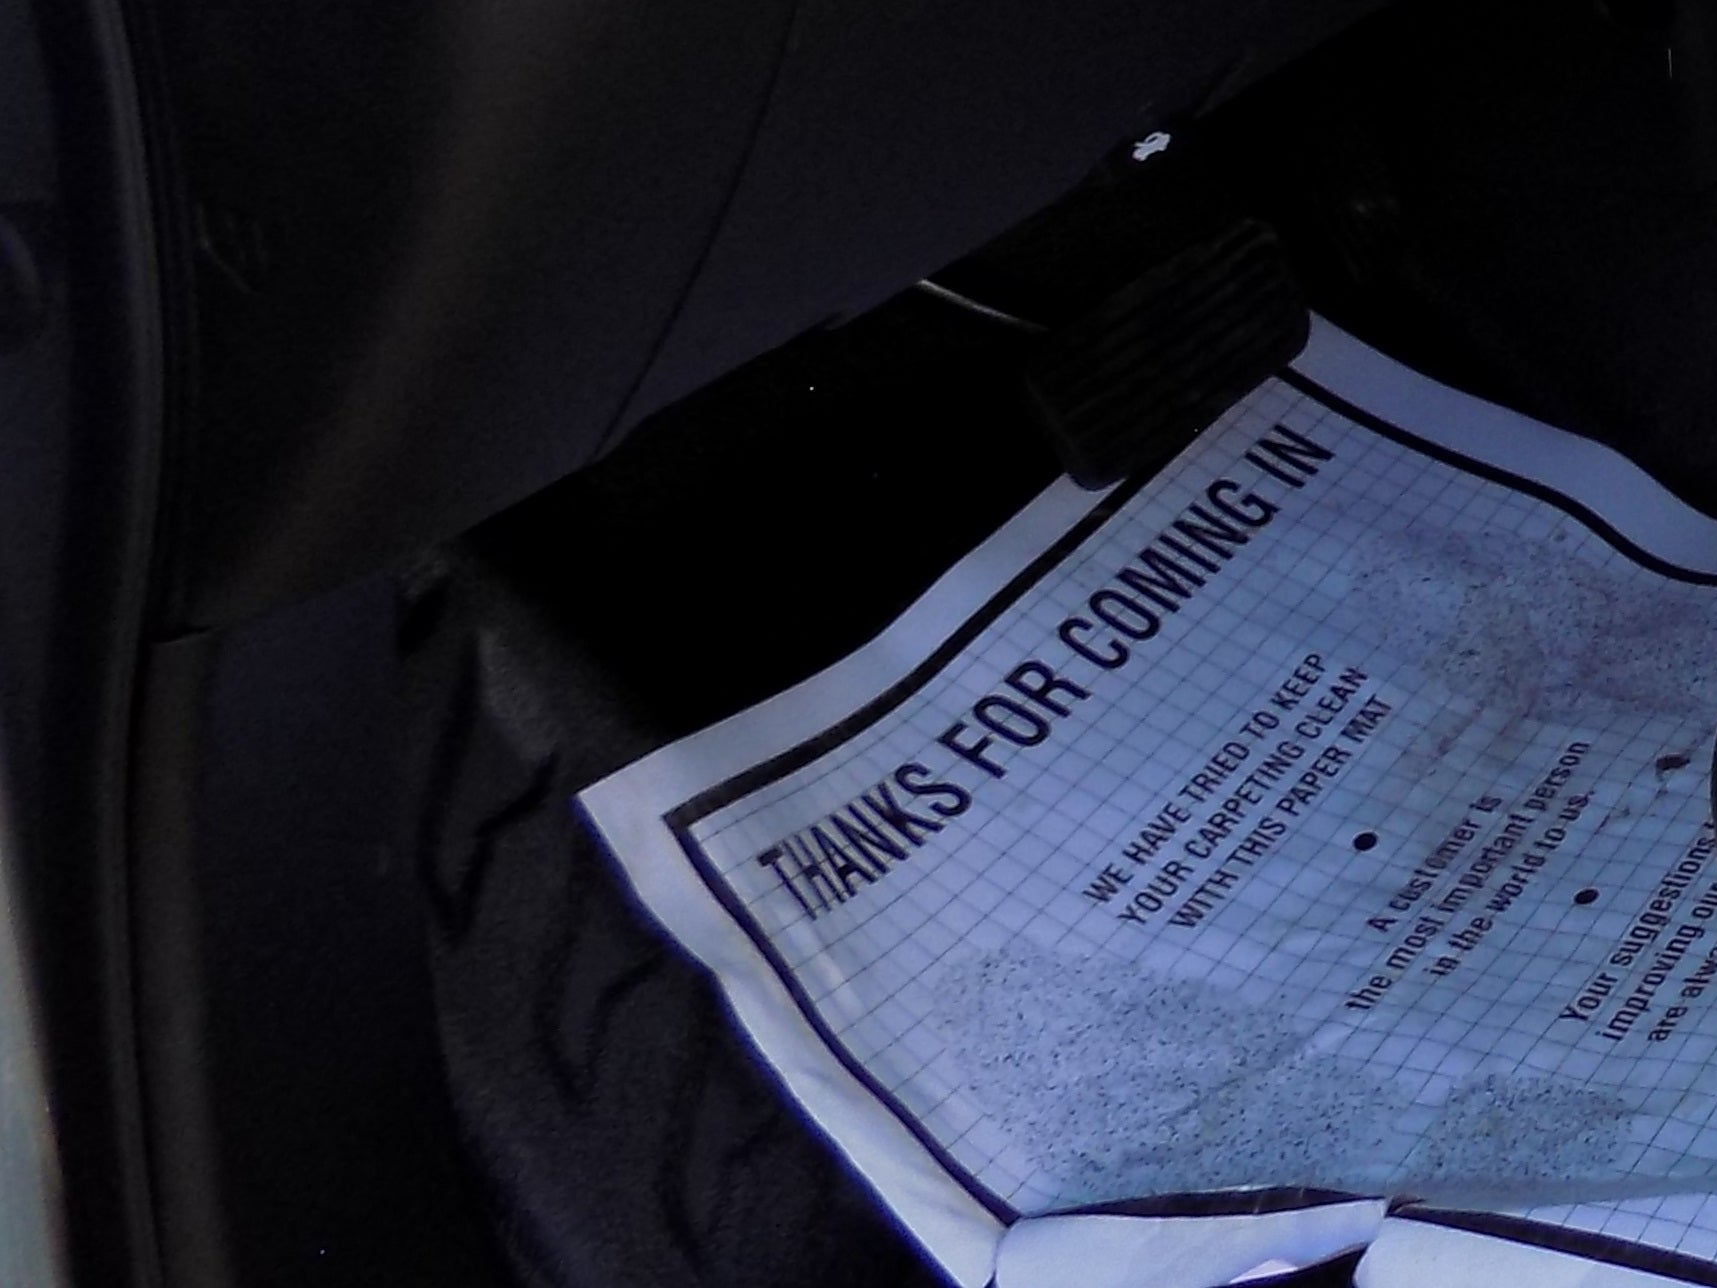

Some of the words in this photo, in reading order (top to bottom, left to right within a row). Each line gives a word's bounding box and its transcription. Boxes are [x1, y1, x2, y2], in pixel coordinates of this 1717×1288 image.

[757, 762, 973, 921] THANKS
[937, 659, 1092, 779] FOR
[1058, 479, 1281, 670] COMING
[1244, 423, 1335, 490] IN
[1082, 863, 1135, 905] WE
[1122, 801, 1192, 866] HAVE
[1178, 740, 1251, 804] TRIED
[1239, 710, 1280, 740] TO
[1270, 652, 1327, 711] KEEP
[1117, 860, 1194, 925] YOUR
[1184, 740, 1305, 860] CARPETING
[1295, 666, 1369, 740] CLEAN
[1168, 870, 1240, 928] WITH
[1227, 817, 1287, 867] THIS
[1276, 746, 1353, 817] PAPER
[1341, 693, 1393, 744] MAT
[1345, 974, 1393, 1011] the
[1386, 915, 1445, 971] most
[1430, 812, 1535, 914] important
[1524, 740, 1591, 813] person
[1366, 916, 1398, 933] A
[1389, 818, 1483, 913] customer
[1470, 793, 1503, 814] is
[1423, 955, 1461, 977] in
[1448, 915, 1494, 952] the
[1485, 852, 1547, 913] world
[1535, 827, 1568, 851] to
[1559, 790, 1597, 823] us.
[1558, 972, 1618, 1022] Your
[1610, 834, 1717, 967] suggestions
[1595, 924, 1706, 1042] improving
[1647, 1005, 1688, 1043] are
